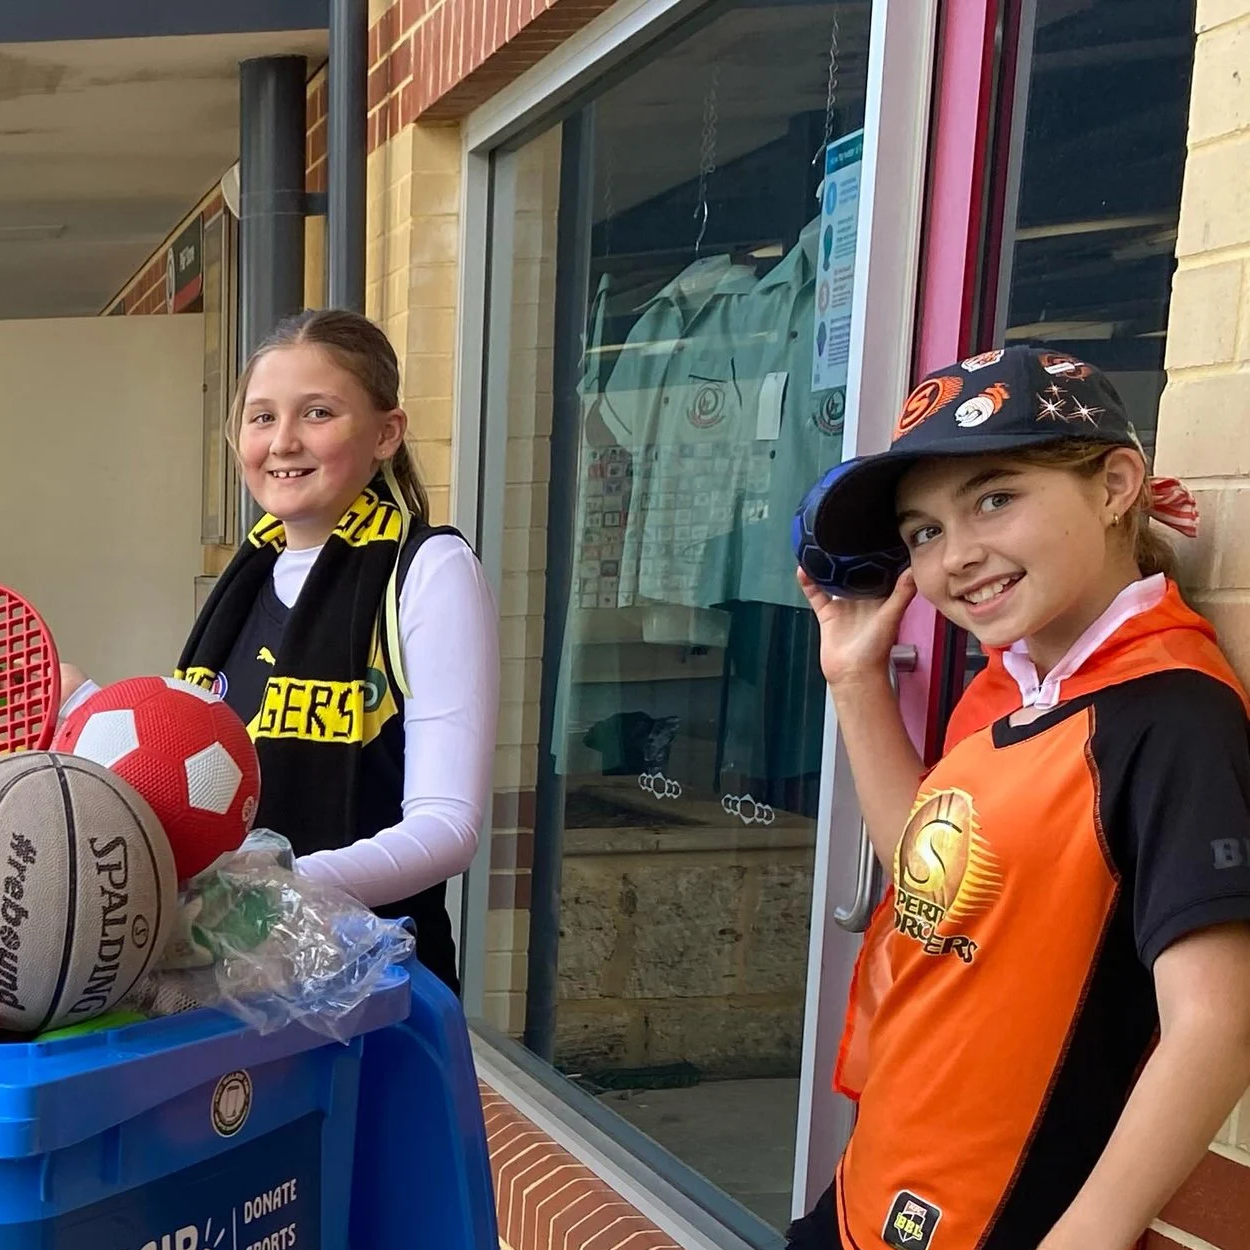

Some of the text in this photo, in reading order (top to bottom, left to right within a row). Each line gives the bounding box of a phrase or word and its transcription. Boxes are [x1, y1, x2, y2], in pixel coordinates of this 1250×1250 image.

[68, 835, 128, 1015] SPALDING
[244, 1178, 297, 1224] DONATE
[894, 1212, 923, 1240] BBL
